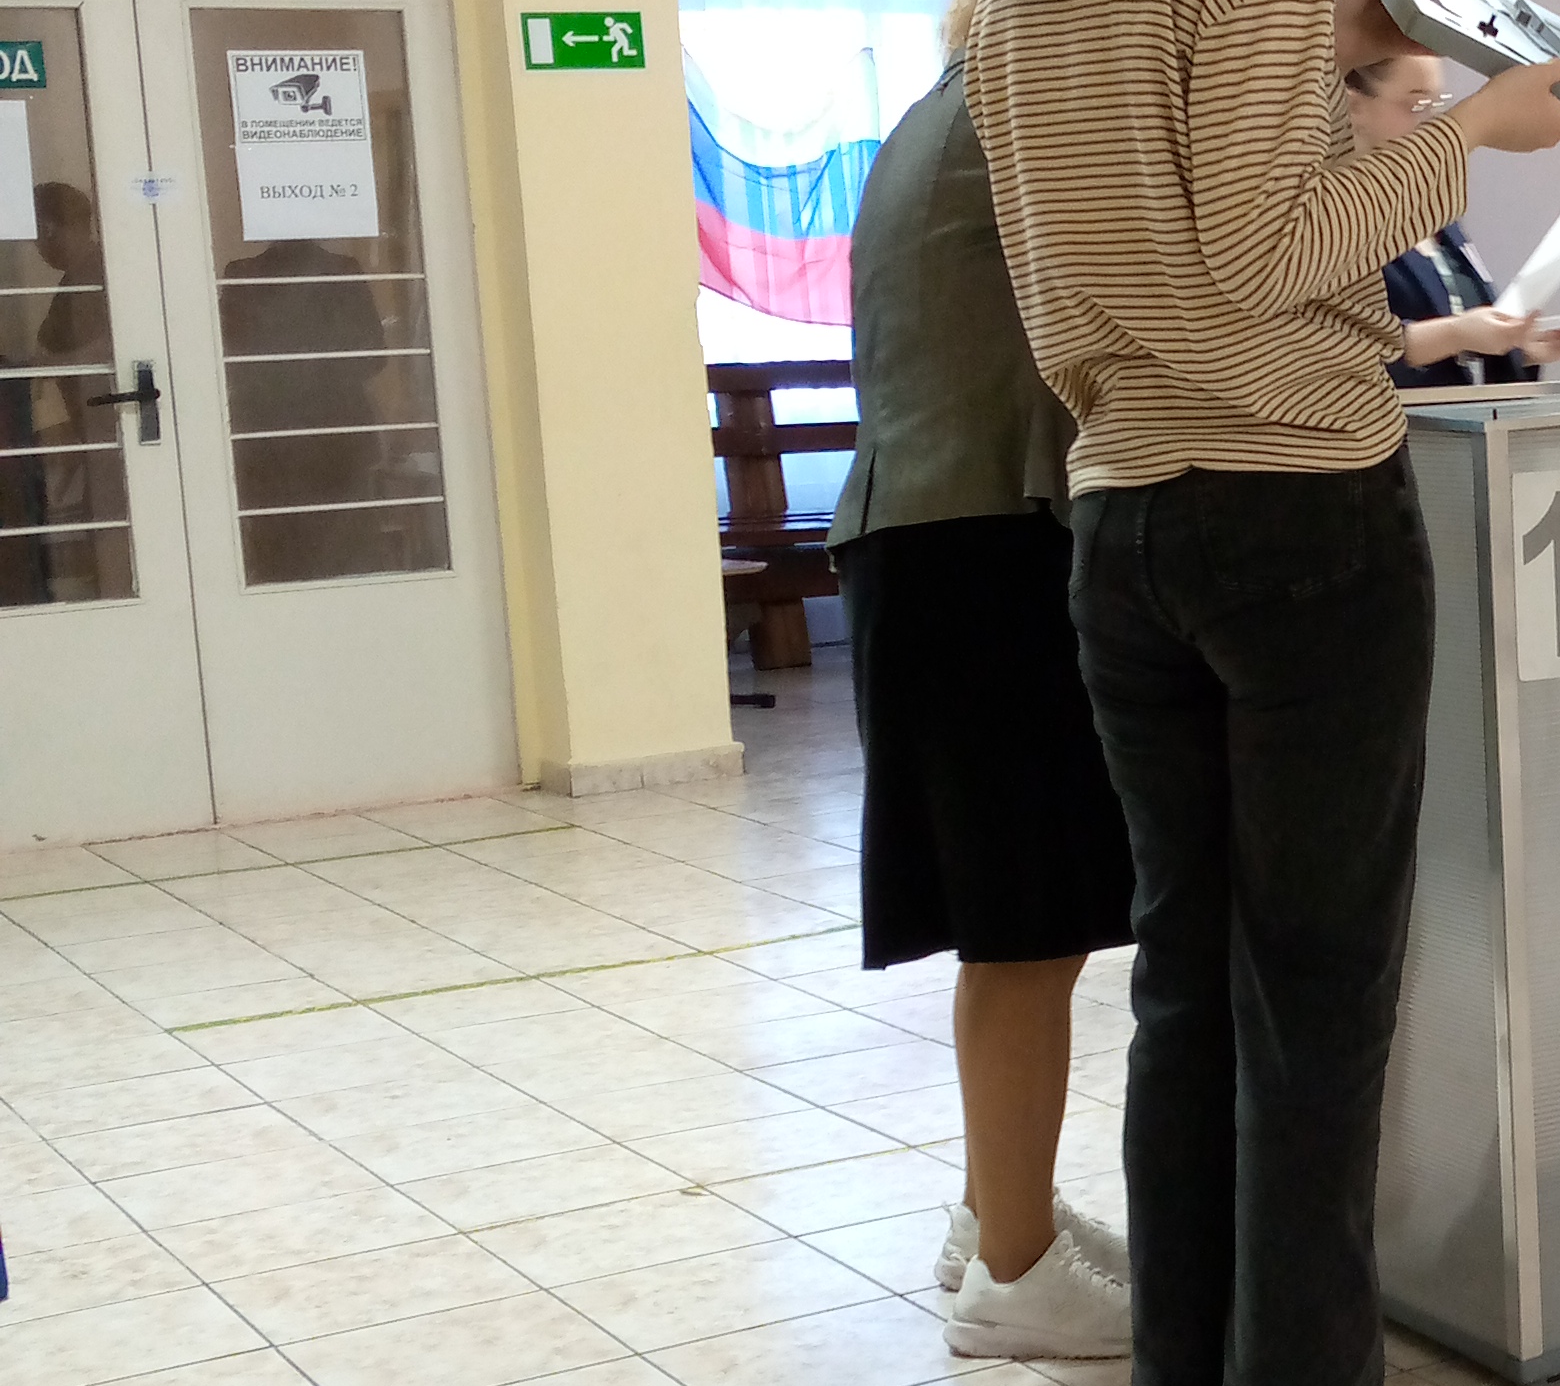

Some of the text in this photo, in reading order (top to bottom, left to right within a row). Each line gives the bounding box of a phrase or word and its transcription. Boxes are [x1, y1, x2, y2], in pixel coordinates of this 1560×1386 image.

[236, 56, 357, 72] ВНИМАНИЕ!
[241, 118, 363, 128] В ПОМЕЩЕНИИ ВЕДЕТСЯ
[242, 128, 363, 140] ВИДЕОНАБЛЮДЕНИЕ
[260, 184, 359, 200] ВЫХОД № 2
